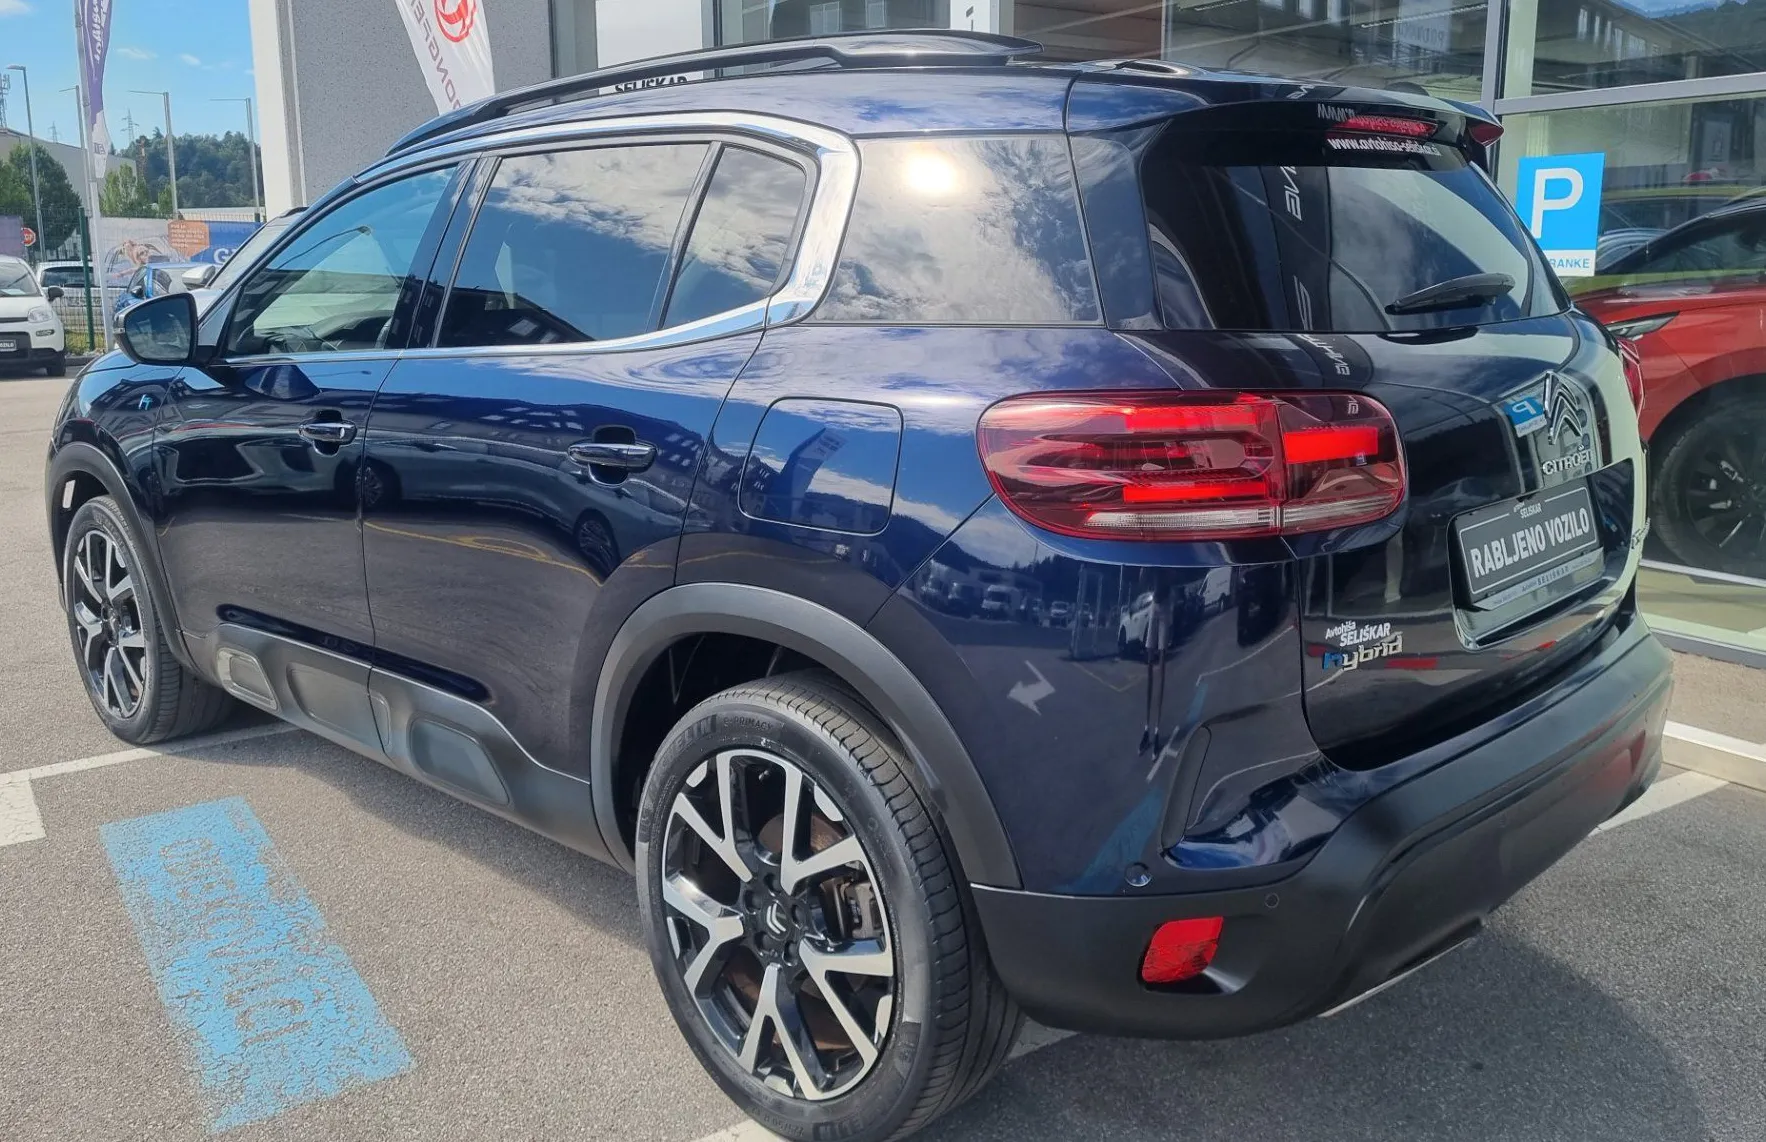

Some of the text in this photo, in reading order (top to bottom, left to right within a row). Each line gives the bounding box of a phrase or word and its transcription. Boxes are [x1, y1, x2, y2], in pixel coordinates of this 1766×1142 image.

[1532, 167, 1584, 239] P
[1470, 524, 1546, 578] RABLJENO
[1545, 507, 1591, 547] VOZILO
[1325, 619, 1356, 639] Avtohiša
[1340, 622, 1392, 647] SELIŠKAR
